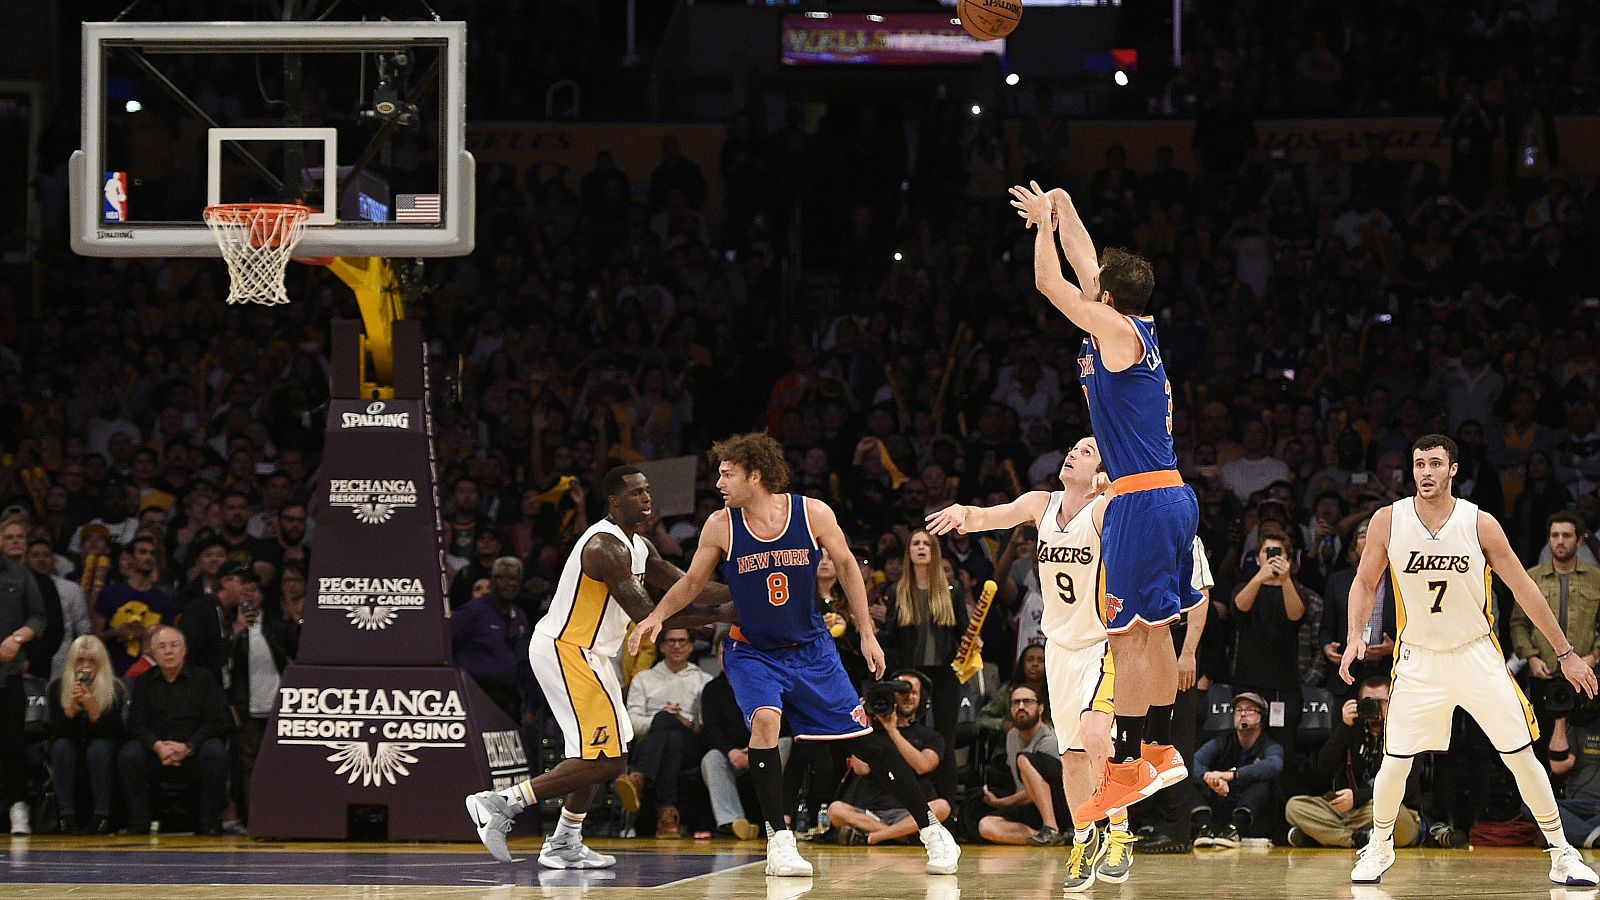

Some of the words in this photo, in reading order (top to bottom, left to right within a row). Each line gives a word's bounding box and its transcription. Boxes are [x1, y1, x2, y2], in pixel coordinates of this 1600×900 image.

[341, 412, 410, 429] SPALDING
[329, 479, 417, 493] PECHANGA
[329, 494, 370, 503] RESORT
[377, 494, 418, 504] CASINO
[736, 551, 770, 574] NEW
[771, 548, 810, 567] YORK
[1038, 539, 1094, 565] LAKERS
[1402, 551, 1470, 574] LAKERS
[318, 577, 426, 593] PECHANGA
[766, 572, 790, 607] 8
[1055, 571, 1077, 605] 9
[317, 595, 367, 605] RESORT
[376, 595, 426, 606] CASINO
[1427, 579, 1448, 614] 7
[279, 687, 467, 716] PECHANGA
[1211, 702, 1234, 714] LT
[277, 719, 365, 738] RESORT
[382, 721, 467, 741] CASINO
